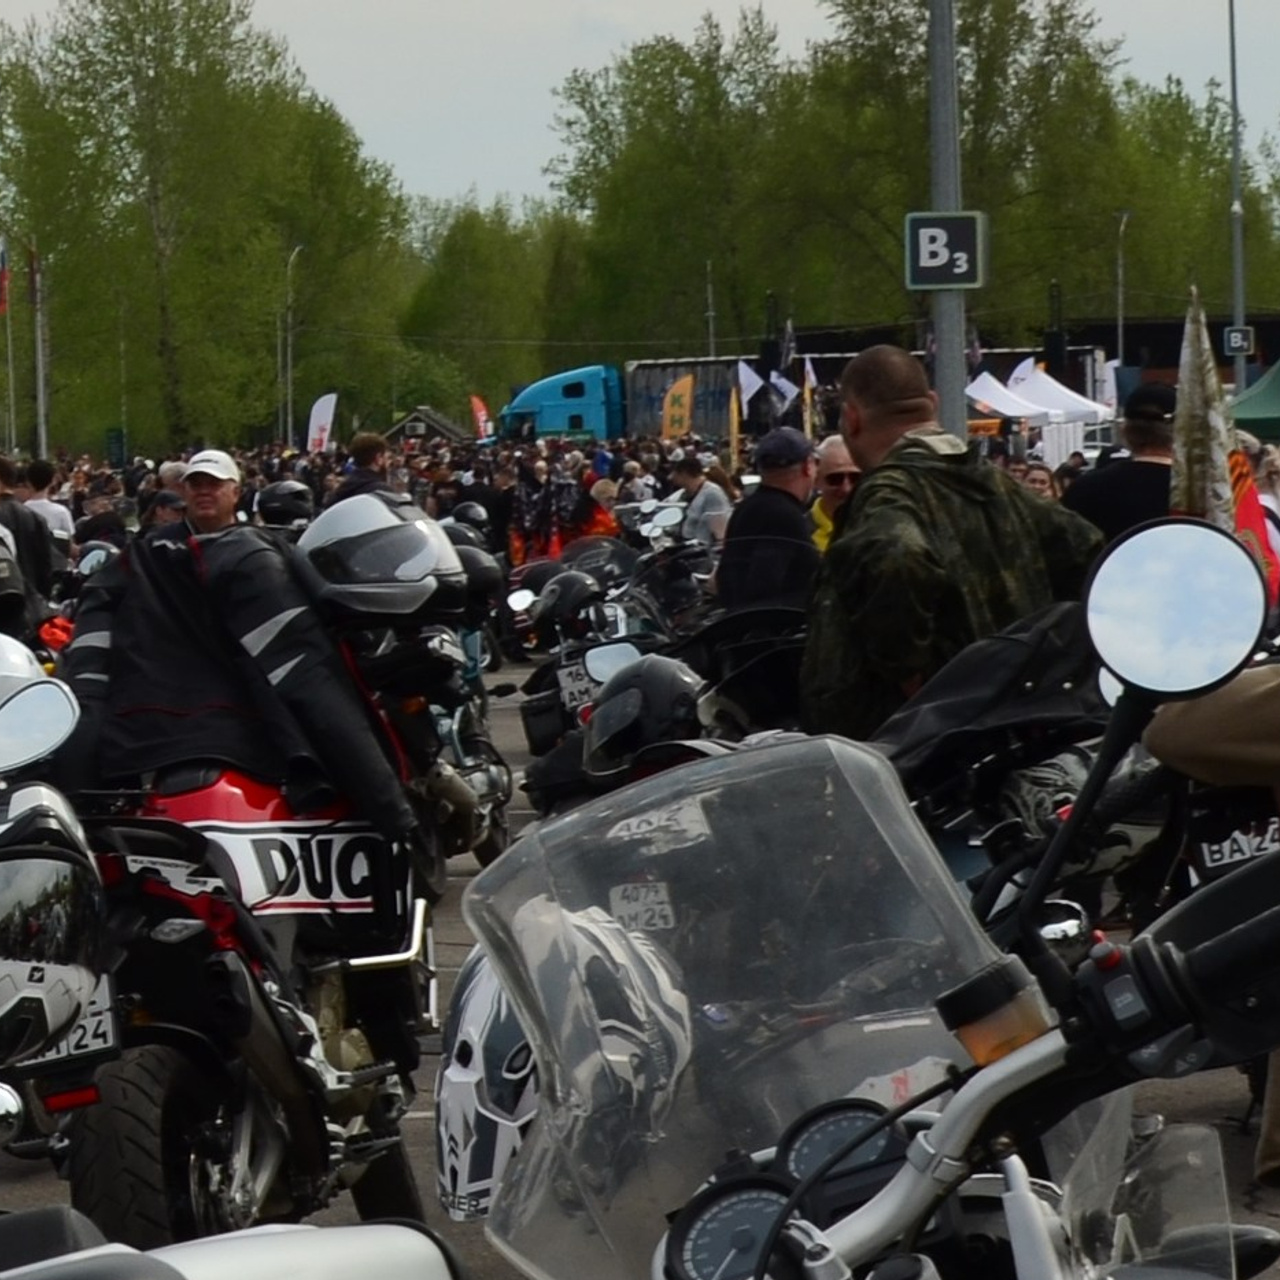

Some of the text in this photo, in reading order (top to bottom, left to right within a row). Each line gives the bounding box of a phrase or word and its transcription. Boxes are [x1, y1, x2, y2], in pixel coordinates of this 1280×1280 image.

[918, 228, 970, 275] B3
[249, 835, 385, 898] DUC
[1208, 836, 1247, 864] BA
[72, 1018, 108, 1051] 24
